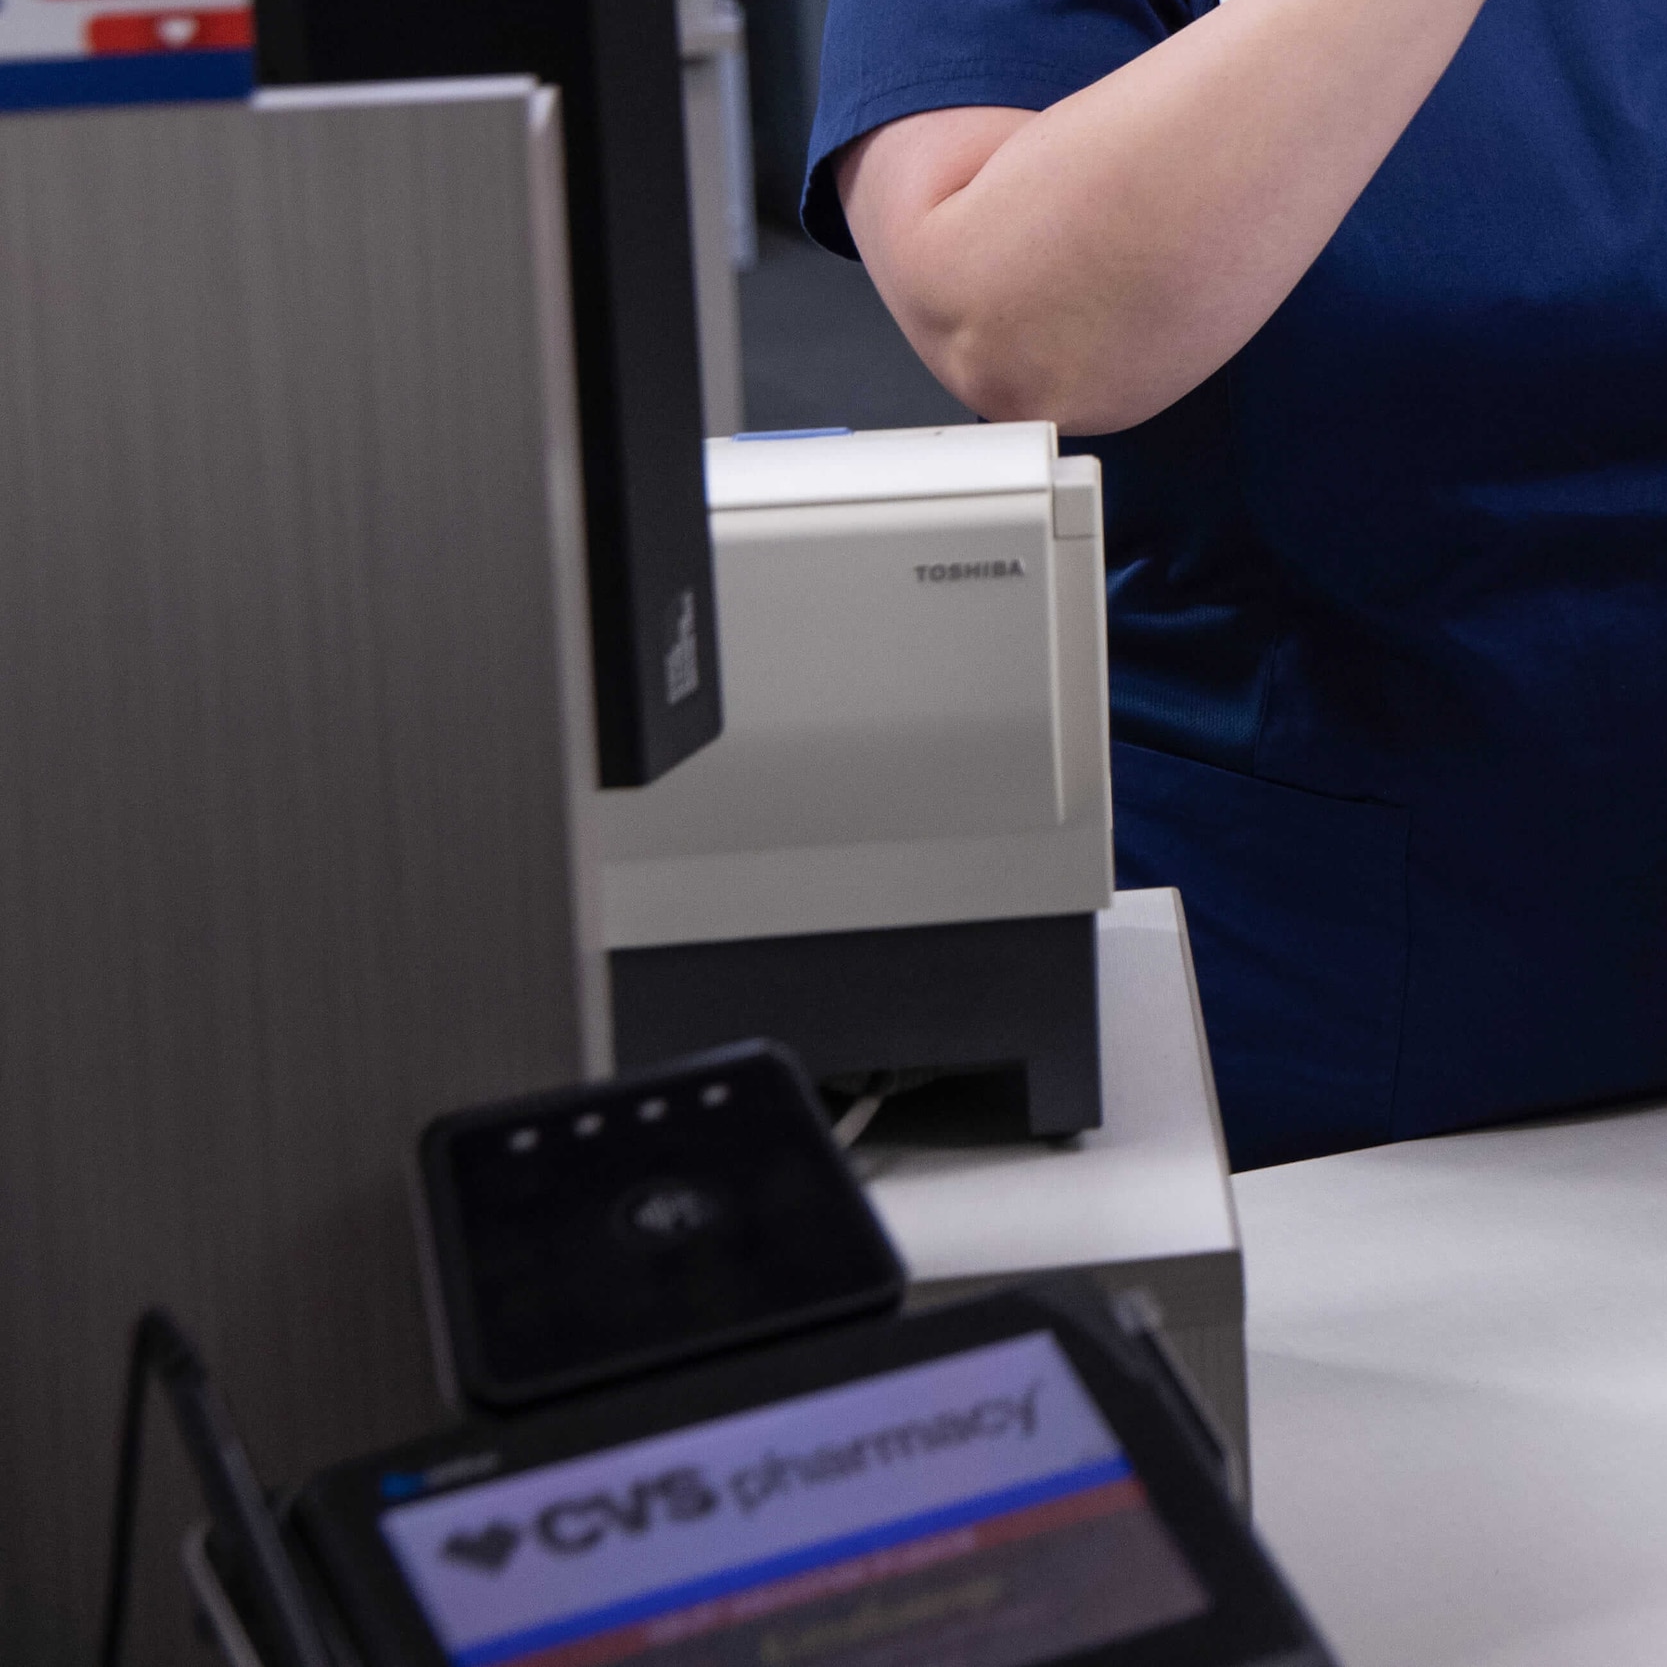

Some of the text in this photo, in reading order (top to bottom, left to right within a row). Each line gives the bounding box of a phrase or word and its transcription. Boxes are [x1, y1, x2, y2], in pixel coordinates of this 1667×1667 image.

[914, 559, 1024, 581] TOSHIBA
[536, 1379, 1045, 1556] CVS pharmacy
